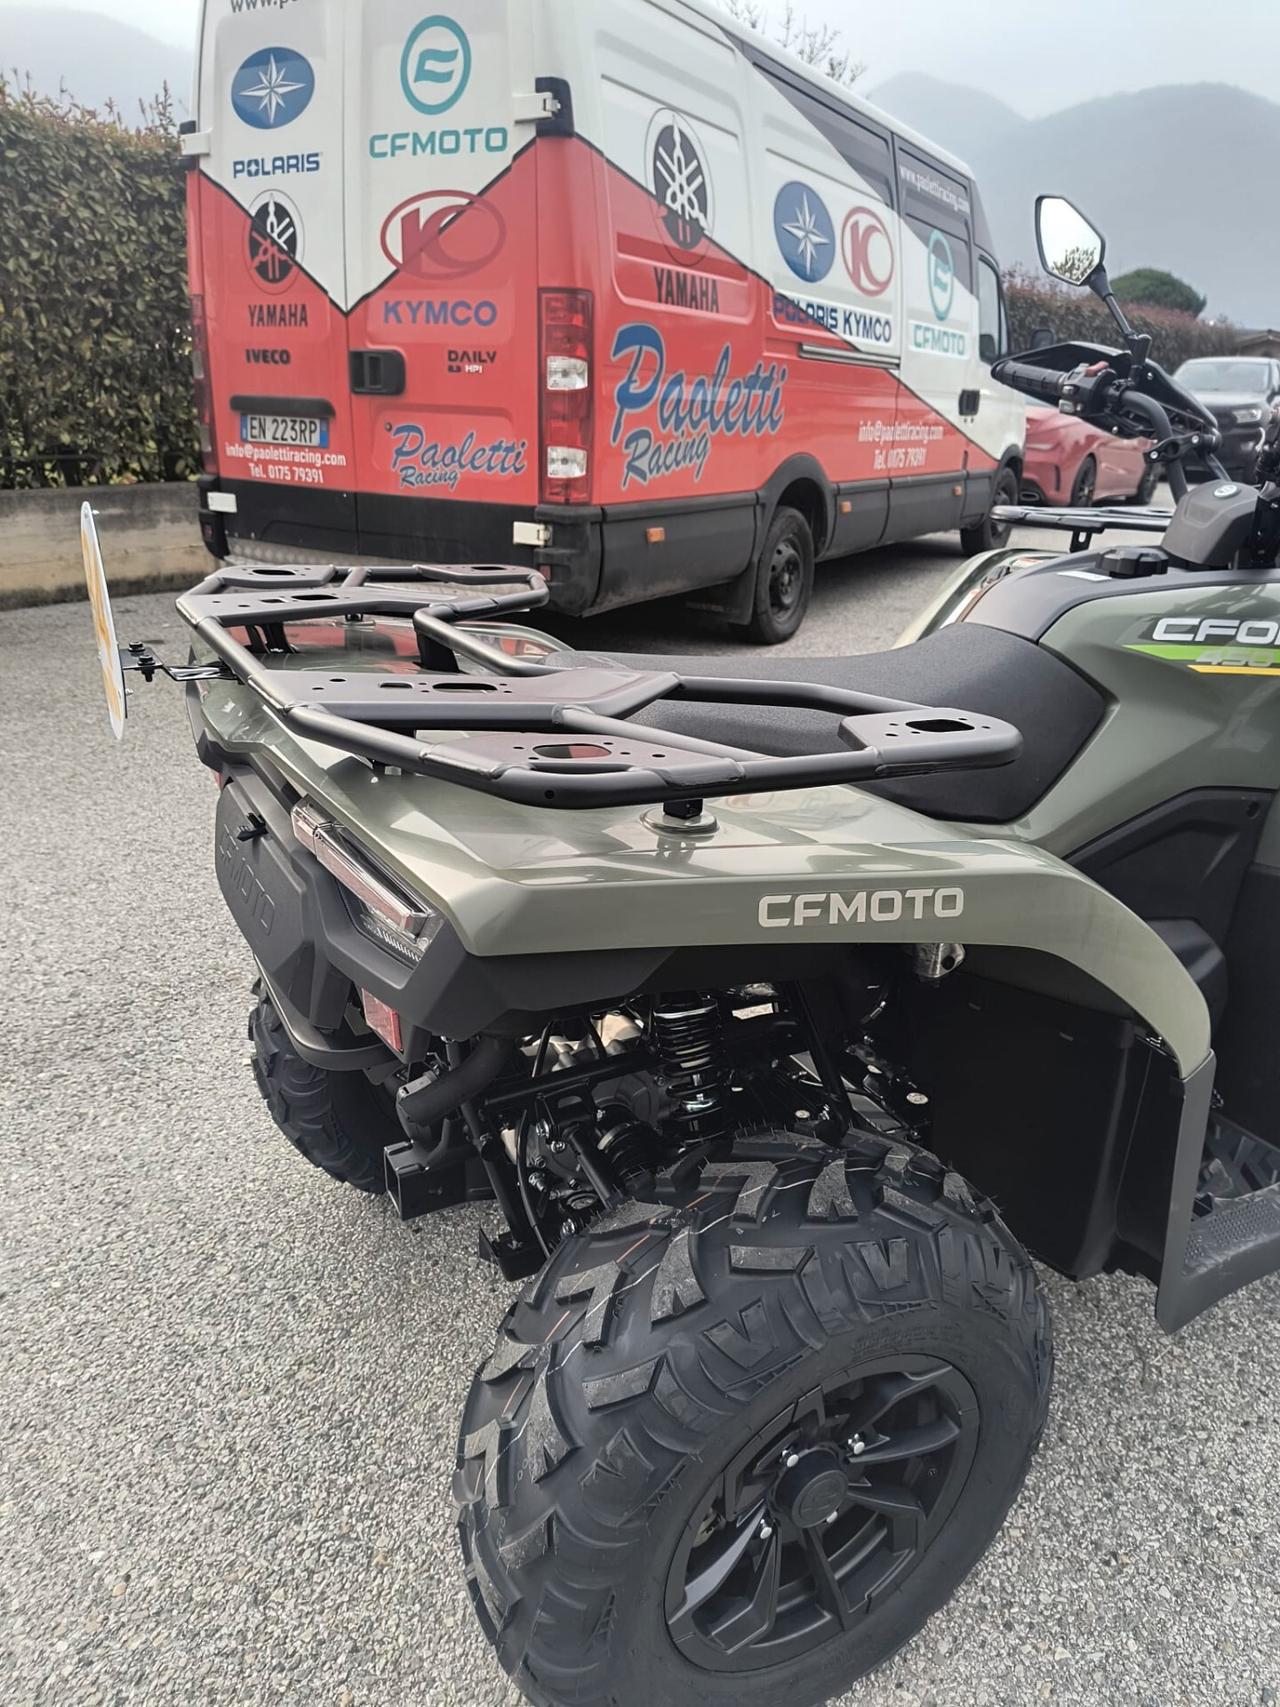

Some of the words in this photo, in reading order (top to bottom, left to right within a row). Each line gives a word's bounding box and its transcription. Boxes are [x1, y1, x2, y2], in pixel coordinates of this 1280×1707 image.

[369, 127, 508, 159] CFMOTO
[233, 152, 321, 179] POLARIS
[654, 267, 720, 314] YAMAHA
[248, 304, 308, 327] YAMAHA
[383, 300, 498, 327] KYMCO
[773, 294, 838, 330] POLARIS
[843, 311, 892, 343] KYMCO
[913, 324, 966, 356] CFMOTO
[245, 348, 291, 365] IVECO
[447, 349, 497, 364] DAILY
[609, 321, 789, 446] Paoletti
[249, 416, 267, 440] EN
[271, 418, 318, 443] 223RP
[225, 442, 347, 467] info@paolettiracing.com
[390, 422, 527, 474] Paoletti
[620, 428, 713, 491] Racing
[267, 465, 291, 480] 0175
[293, 467, 324, 483] 79391
[399, 466, 461, 492] Racing
[1152, 617, 1280, 645] CFO
[757, 887, 965, 928] CFMOTO
